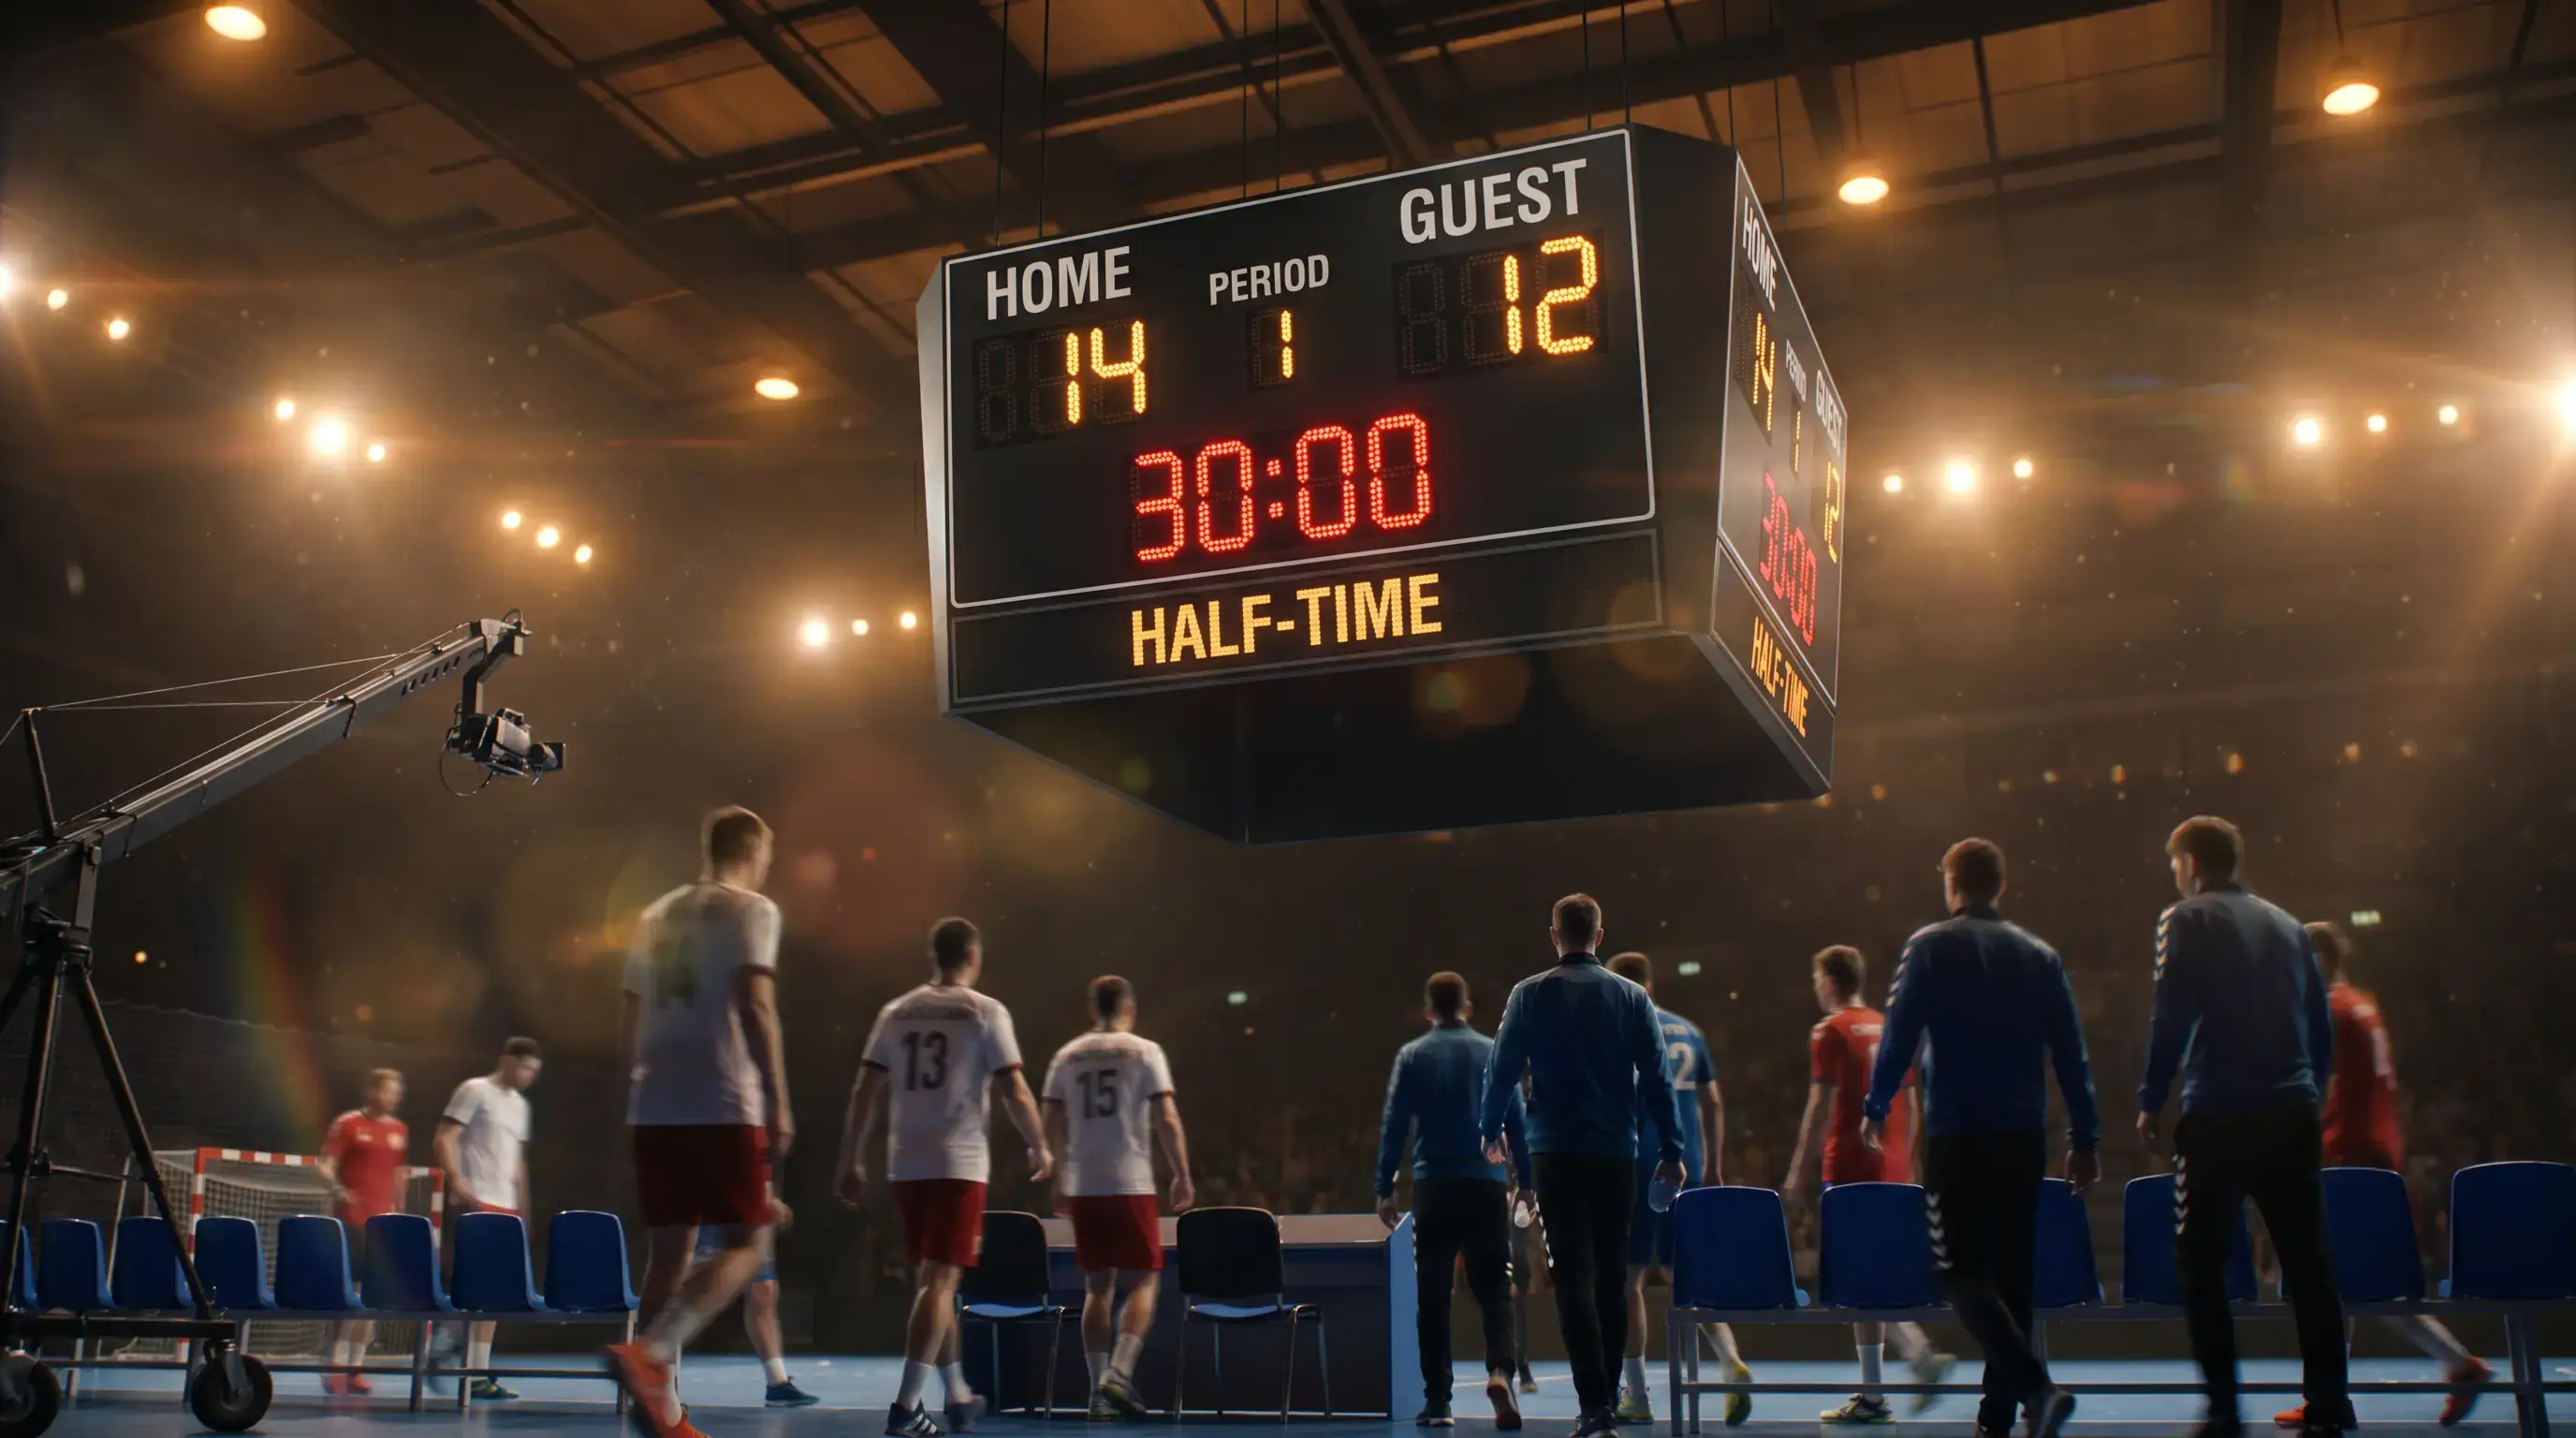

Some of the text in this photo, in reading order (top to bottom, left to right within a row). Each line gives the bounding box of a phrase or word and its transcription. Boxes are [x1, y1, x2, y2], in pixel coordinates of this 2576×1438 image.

[1400, 159, 1587, 244] GUEST
[986, 246, 1132, 320] HOME
[1209, 254, 1329, 305] PERIOD
[1503, 234, 1599, 356] 12
[1742, 195, 1778, 313] HOME
[1065, 320, 1147, 425] 14
[1280, 310, 1294, 378] 1
[1752, 312, 1776, 432] 14
[1785, 338, 1808, 404] PERIOD
[1794, 410, 1801, 473] 1
[1816, 368, 1843, 458] GUEST
[1134, 412, 1432, 562] 30:00
[1824, 461, 1841, 565] 12
[1759, 471, 1818, 647] 30:00
[1131, 572, 1443, 667] HALF-TIME
[1749, 615, 1809, 739] HALF-TIME
[900, 1031, 948, 1092] 13
[1075, 1069, 1120, 1119] 15
[1668, 1041, 1696, 1091] 2
